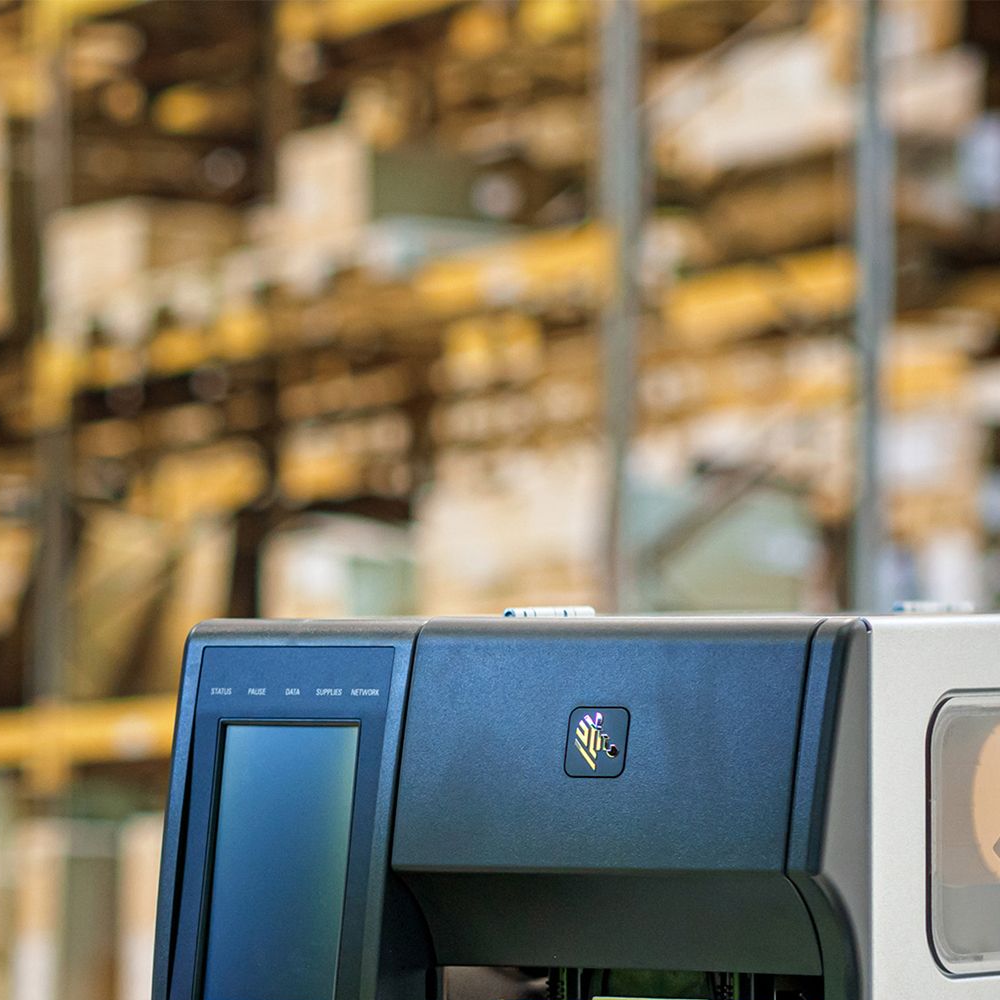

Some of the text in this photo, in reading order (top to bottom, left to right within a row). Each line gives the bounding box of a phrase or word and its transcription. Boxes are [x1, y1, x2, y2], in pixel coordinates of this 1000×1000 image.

[210, 687, 232, 696] STATUS
[247, 687, 267, 696] PAUSE
[285, 688, 300, 696] DATA
[315, 688, 343, 697] SUPPLIES
[350, 688, 380, 697] NETWORK
